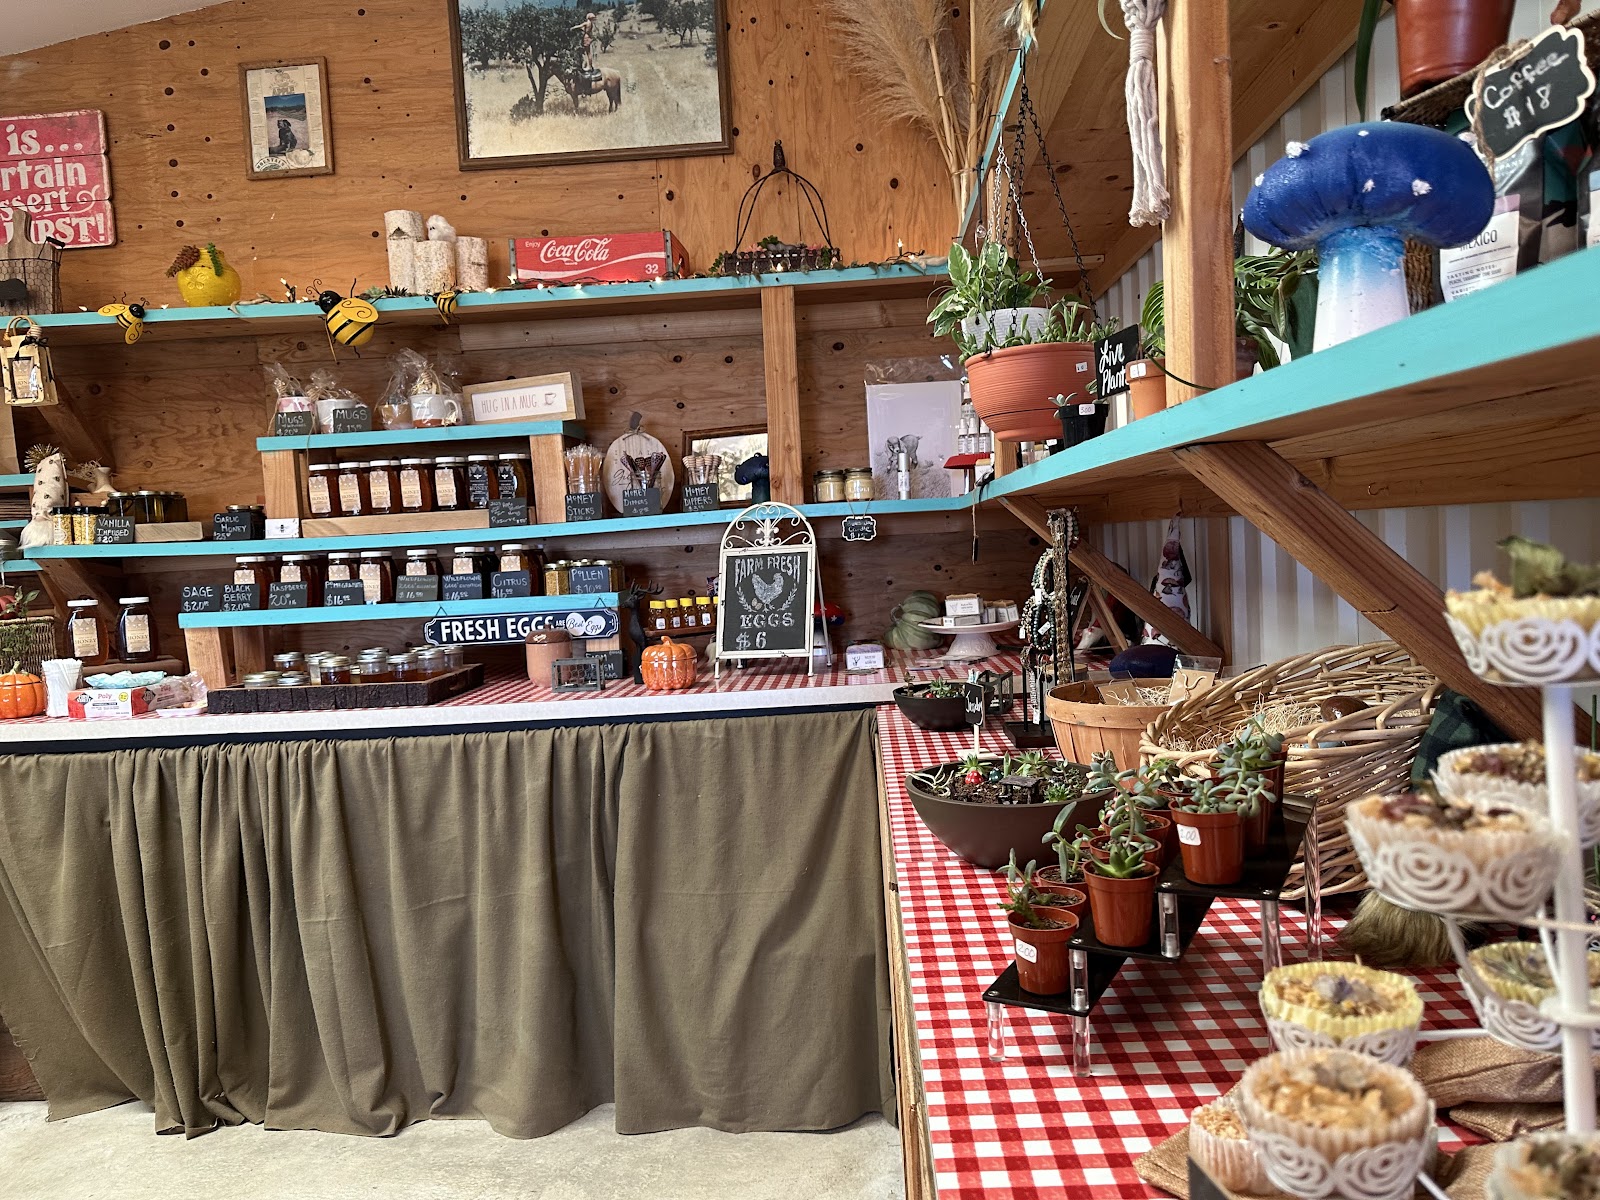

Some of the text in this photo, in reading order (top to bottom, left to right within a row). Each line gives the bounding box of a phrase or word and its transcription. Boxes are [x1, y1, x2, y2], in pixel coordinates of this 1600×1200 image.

[1483, 52, 1569, 109] Coffee
[0, 157, 87, 191] rtain
[540, 238, 613, 265] Coca-Cola
[645, 263, 659, 274] 32
[1099, 339, 1125, 374] Live
[481, 394, 537, 413] HUG IN A MUG
[335, 409, 368, 420] MUGS
[685, 486, 710, 497] HONEY
[566, 494, 594, 504] HONEY
[567, 505, 595, 516] STICKS
[98, 518, 130, 528] VANILLA
[221, 523, 247, 533] HONEY
[97, 528, 129, 537] INFUSED
[571, 568, 604, 582] POLLEN
[735, 555, 801, 588] FARM FRESH
[492, 573, 528, 587] CITRUS
[182, 586, 214, 598] SAGE
[224, 584, 251, 593] BLACK
[270, 582, 307, 592] RASPBERRY
[223, 593, 252, 602] BERRY
[740, 612, 795, 629] EGGS
[440, 619, 500, 642] FRESH
